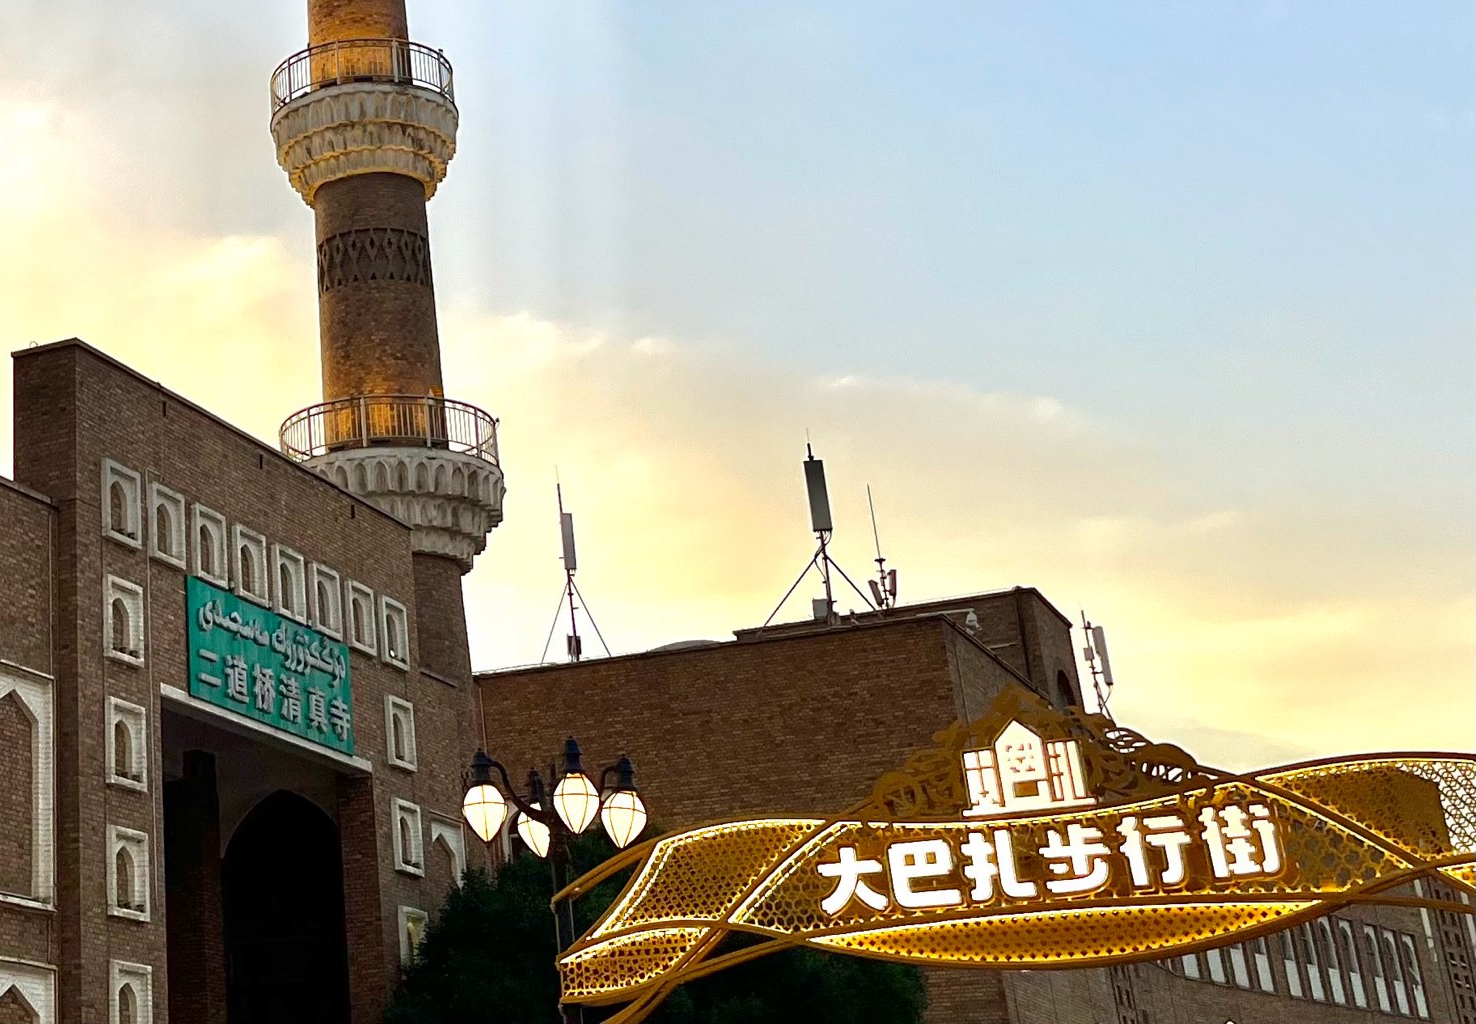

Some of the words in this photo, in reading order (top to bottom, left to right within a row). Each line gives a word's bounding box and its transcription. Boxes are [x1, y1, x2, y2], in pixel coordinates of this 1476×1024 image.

[199, 649, 351, 740] 二道桥清真寺
[818, 804, 1282, 917] 大巴扎步行街
